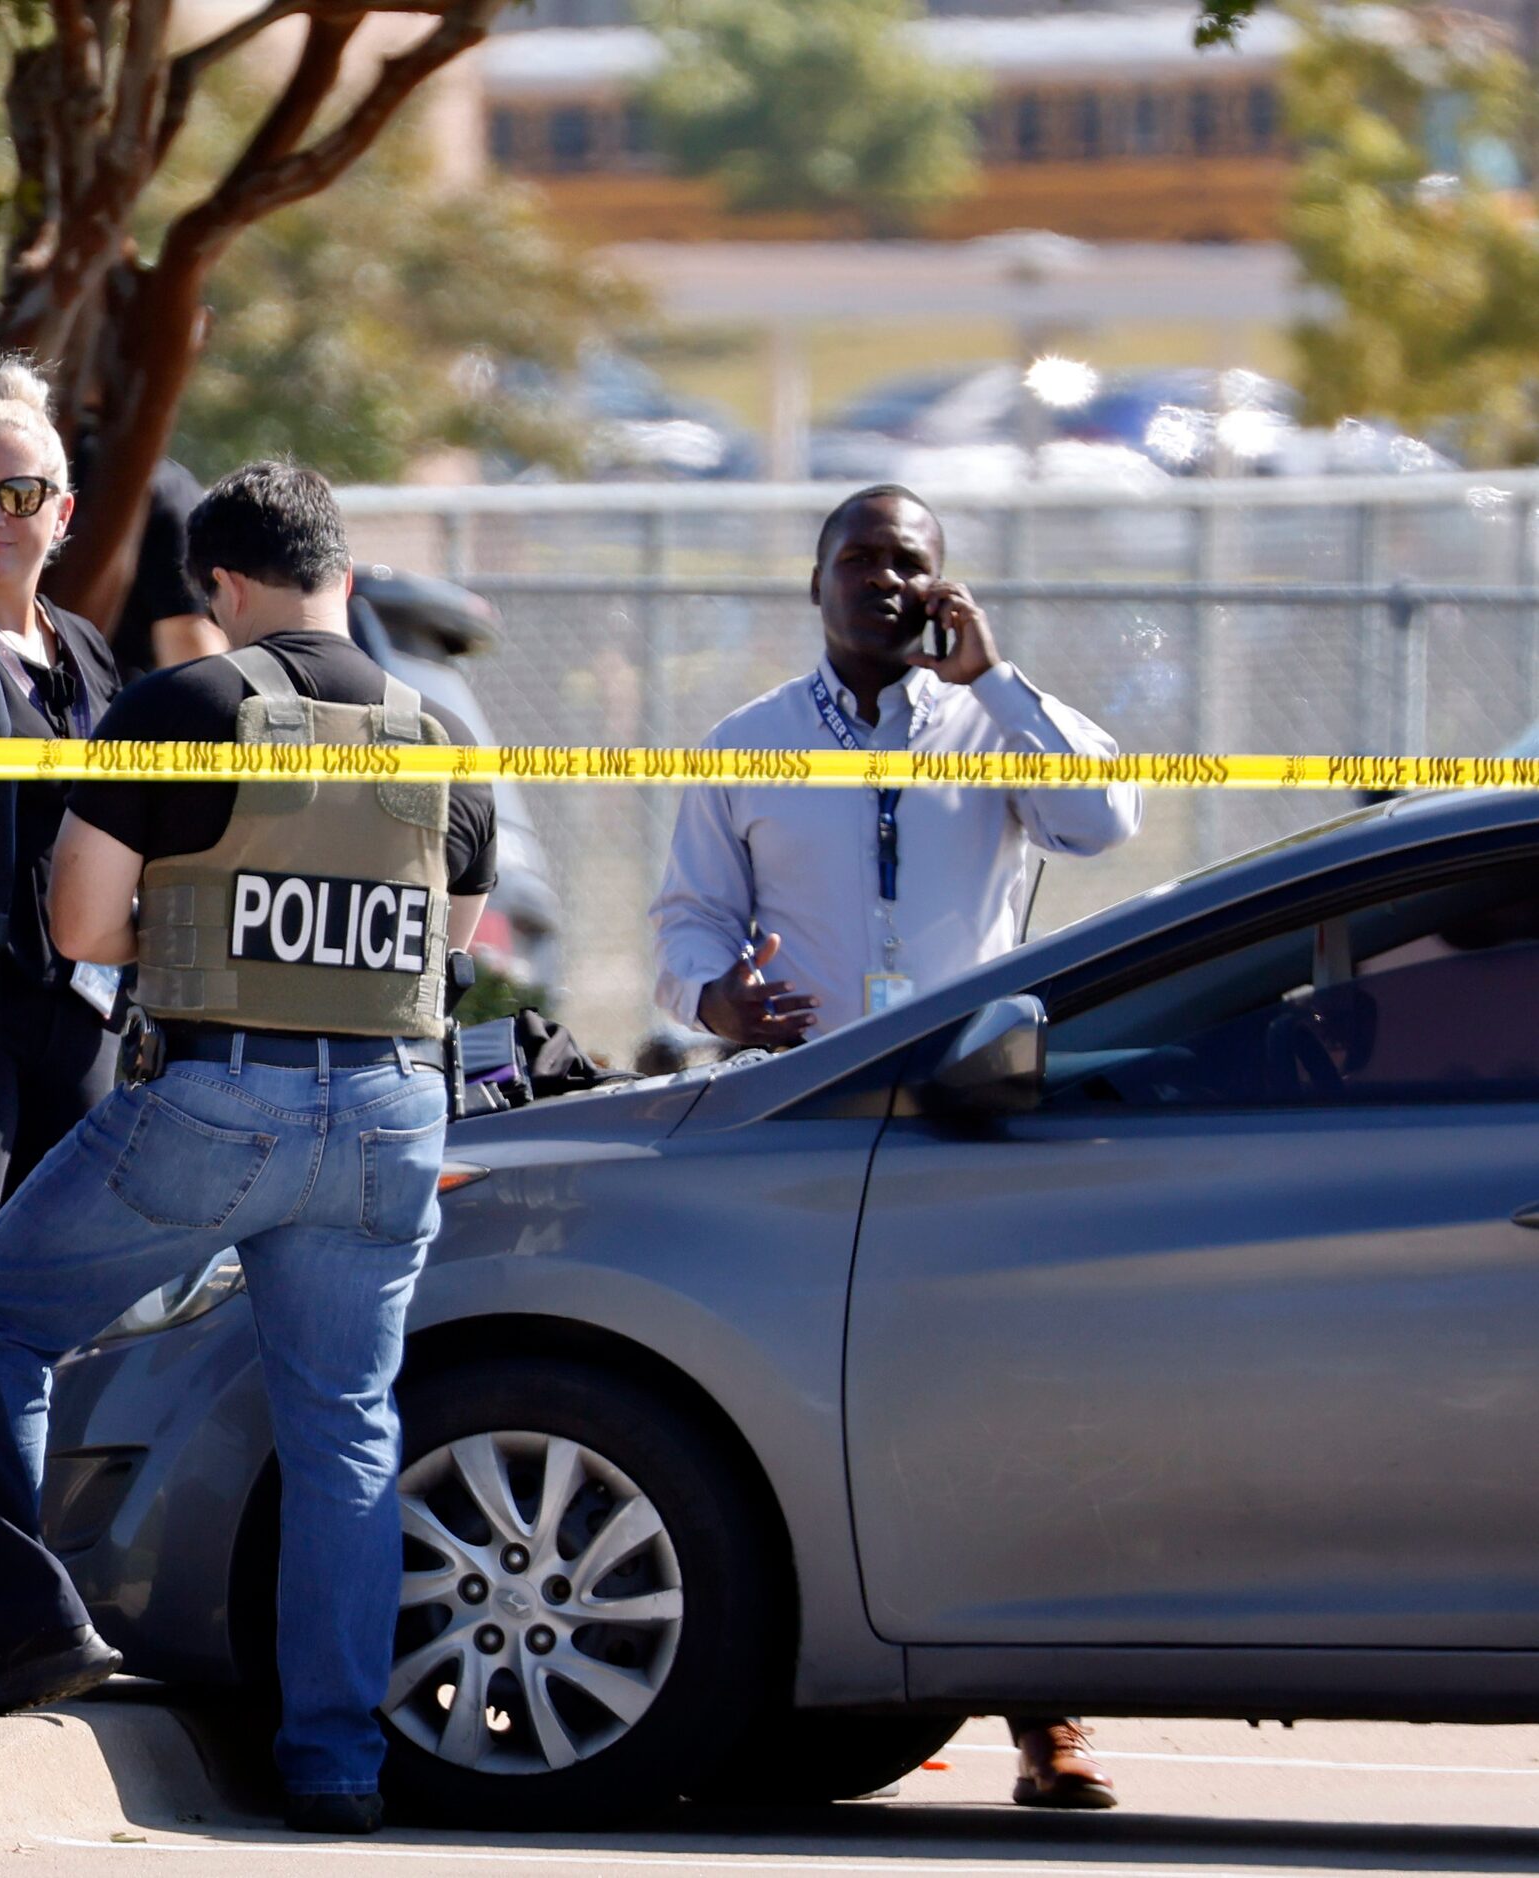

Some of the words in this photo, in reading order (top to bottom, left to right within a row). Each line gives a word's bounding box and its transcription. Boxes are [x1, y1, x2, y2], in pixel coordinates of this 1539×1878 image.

[823, 703, 847, 738] PEER
[85, 740, 166, 771] POLICE
[172, 741, 224, 772] LINE
[231, 742, 264, 773] DO
[270, 743, 311, 774] NOT
[322, 744, 401, 775] CROSS
[499, 747, 579, 777] POLICE
[586, 747, 637, 777] LINE
[644, 748, 676, 778] DO
[683, 749, 724, 778] NOT
[734, 749, 812, 779] CROSS
[911, 751, 993, 781] POLICE
[1001, 752, 1052, 782] LINE
[1060, 753, 1092, 783] DO
[1098, 754, 1141, 783] NOT
[1151, 754, 1229, 785] CROSS
[1328, 756, 1408, 786] POLICE
[1415, 757, 1466, 786] LINE
[1474, 758, 1504, 786] DO
[232, 874, 429, 972] POLICE
